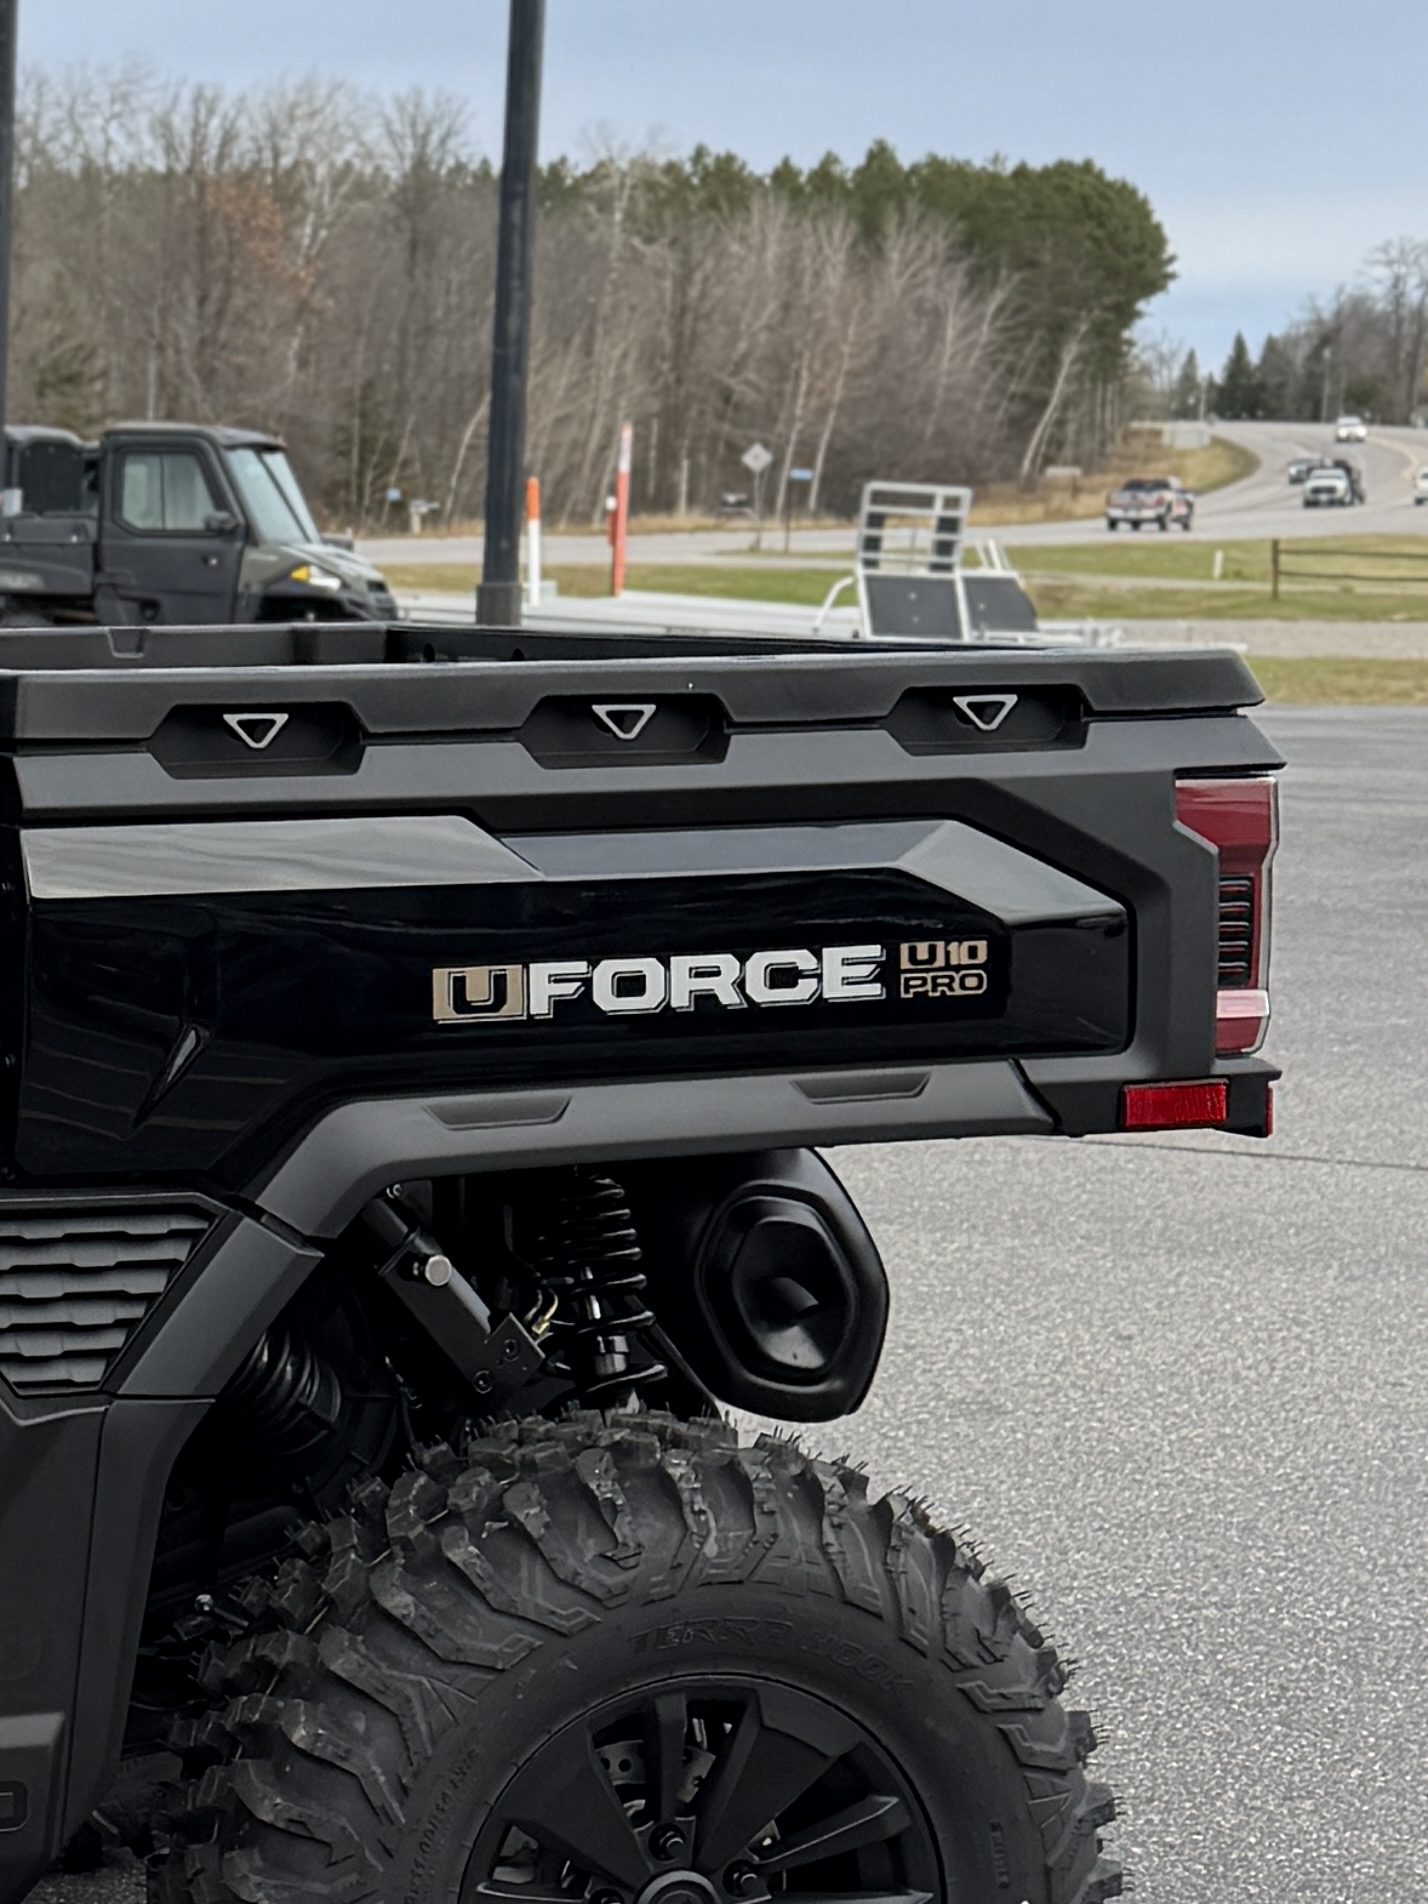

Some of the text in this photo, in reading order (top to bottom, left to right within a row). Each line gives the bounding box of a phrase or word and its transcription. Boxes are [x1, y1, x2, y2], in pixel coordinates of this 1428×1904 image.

[432, 939, 988, 1024] UFORCE U10
[899, 969, 988, 998] PRO
